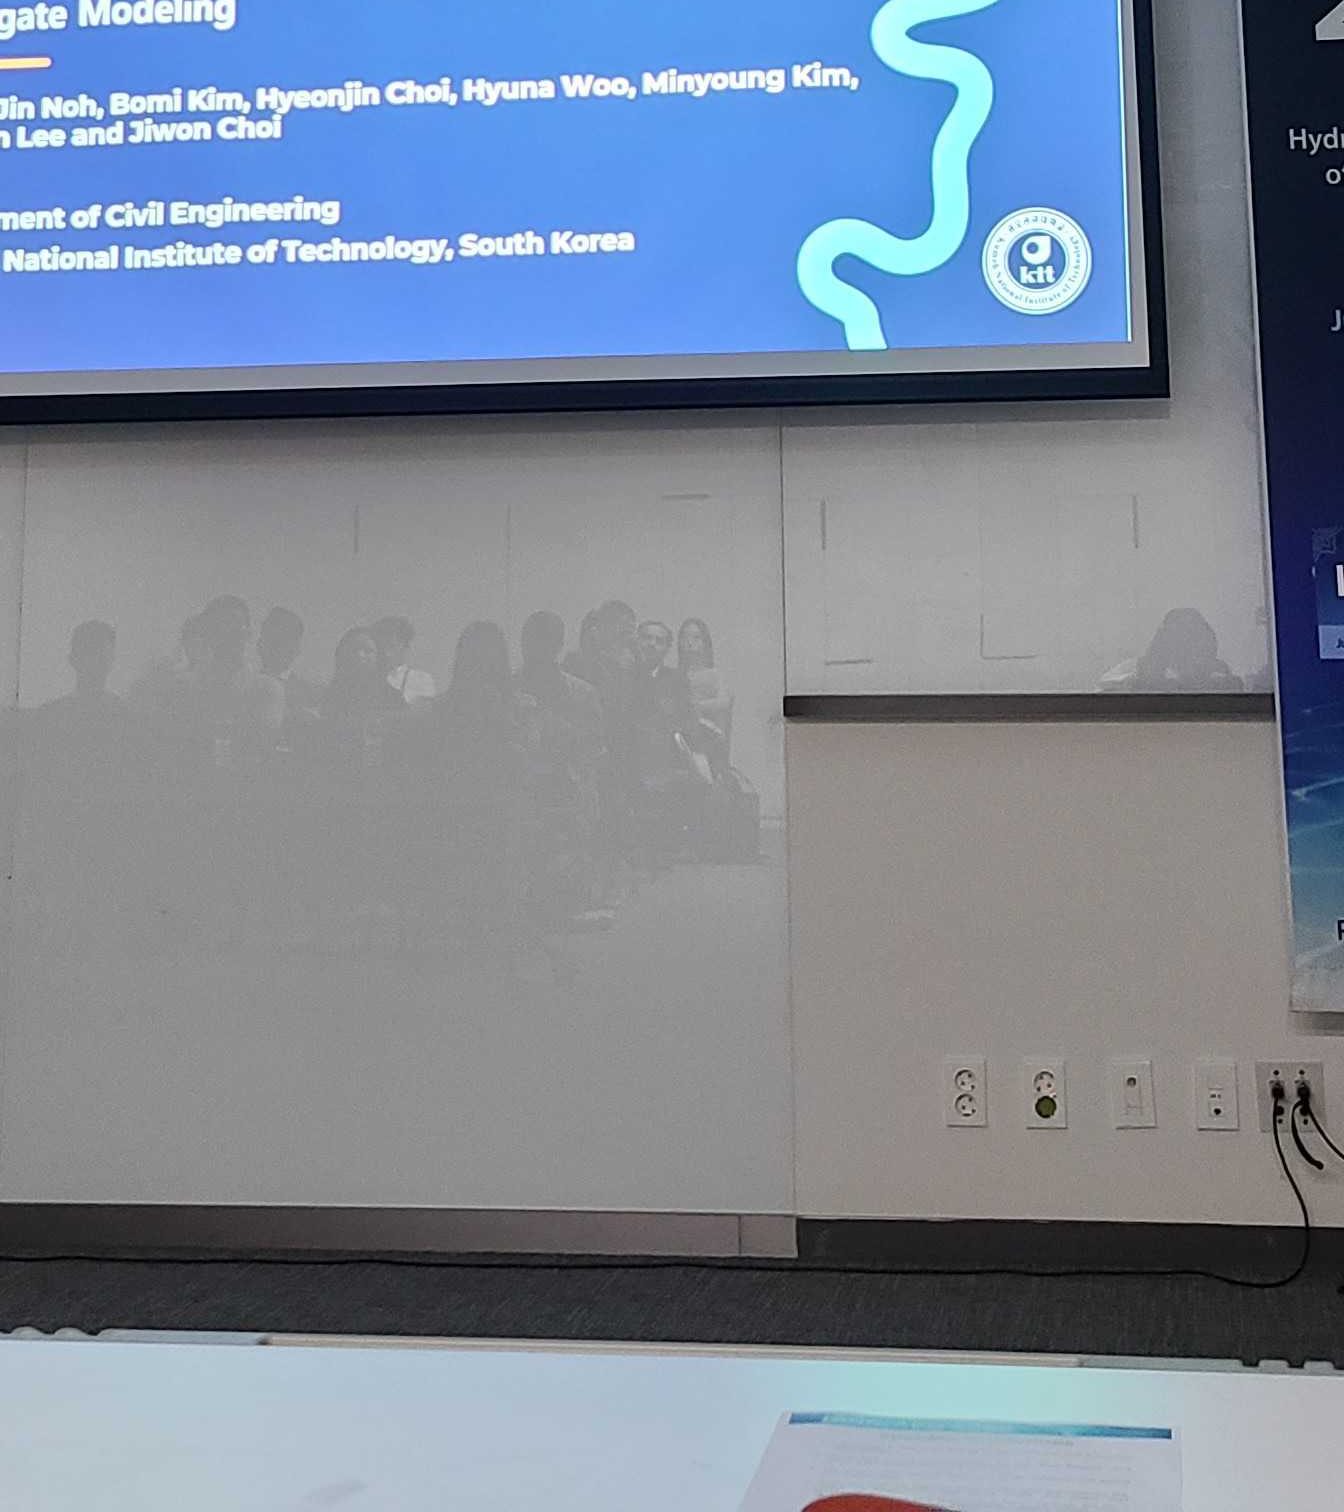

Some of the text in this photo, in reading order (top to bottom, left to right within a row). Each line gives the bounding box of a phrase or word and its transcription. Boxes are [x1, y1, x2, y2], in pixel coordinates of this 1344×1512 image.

[41, 94, 105, 121] Noh,
[110, 88, 183, 116] Bomi
[188, 86, 251, 116] Kim,
[256, 81, 380, 115] Hyeonjin
[385, 77, 458, 107] Choi,
[463, 75, 555, 106] Hyuna
[562, 73, 637, 101] Woo,
[642, 66, 786, 99] Minyoung
[792, 63, 859, 92] Kim,
[17, 125, 66, 148] Lee
[71, 121, 124, 146] and
[128, 117, 211, 143] Jiwon
[216, 114, 283, 140] Choi
[71, 201, 102, 229] of
[105, 199, 164, 227] Civil
[170, 196, 341, 227] Engineering
[3, 244, 119, 272] National
[125, 241, 240, 268] Institute
[247, 238, 278, 264] of
[284, 234, 454, 266] Technology,
[458, 231, 545, 257] South
[551, 229, 635, 255] Korea
[1020, 265, 1056, 283] kit
